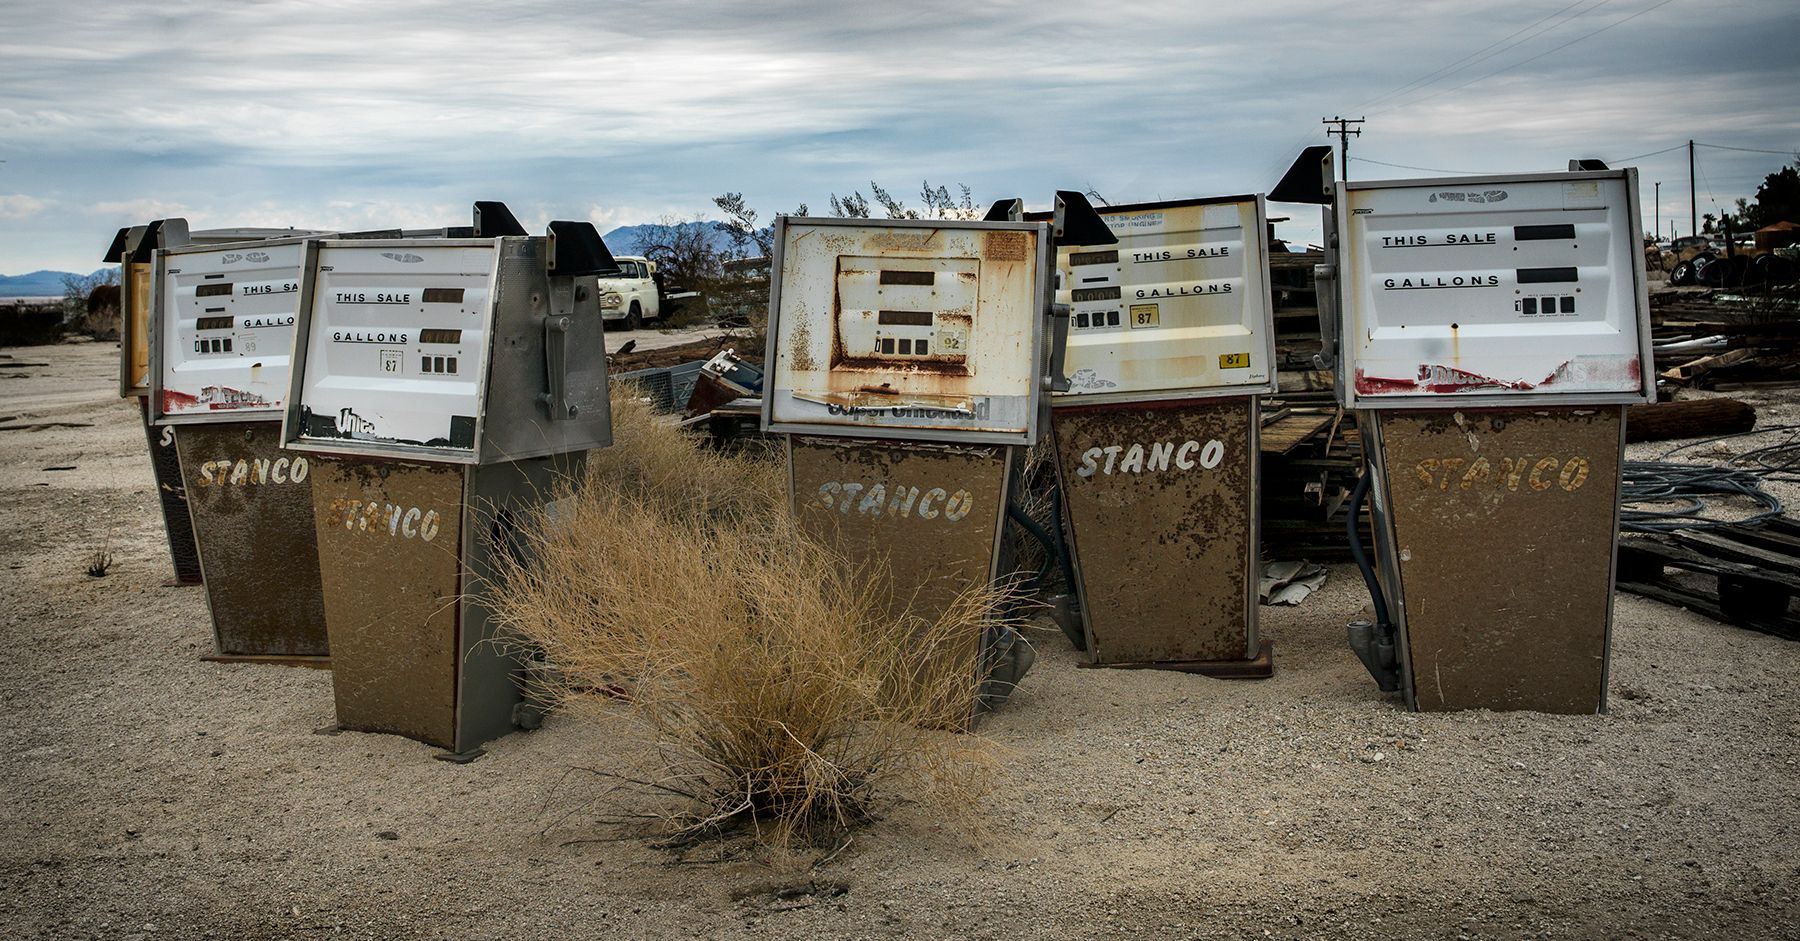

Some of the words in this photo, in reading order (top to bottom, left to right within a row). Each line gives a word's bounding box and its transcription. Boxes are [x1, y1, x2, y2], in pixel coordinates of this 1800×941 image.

[1382, 235, 1427, 246] THIS
[1446, 233, 1496, 244] SALE
[1133, 252, 1171, 262] THIS
[1187, 247, 1229, 258] SALE
[1384, 275, 1499, 288] GALLONS
[243, 285, 272, 294] THIS
[283, 283, 298, 291] SA
[1136, 283, 1232, 298] GALLONS
[336, 293, 365, 302] THIS
[377, 294, 410, 303] SALE
[244, 317, 295, 327] GALLO
[1137, 313, 1152, 324] 87
[333, 332, 408, 343] GALLONS
[1227, 354, 1240, 364] 87
[1077, 439, 1225, 478] STANCO
[199, 457, 309, 487] STANCO
[1416, 456, 1590, 492] STANCO
[814, 481, 973, 522] STANCO
[326, 498, 440, 542] STANCO
